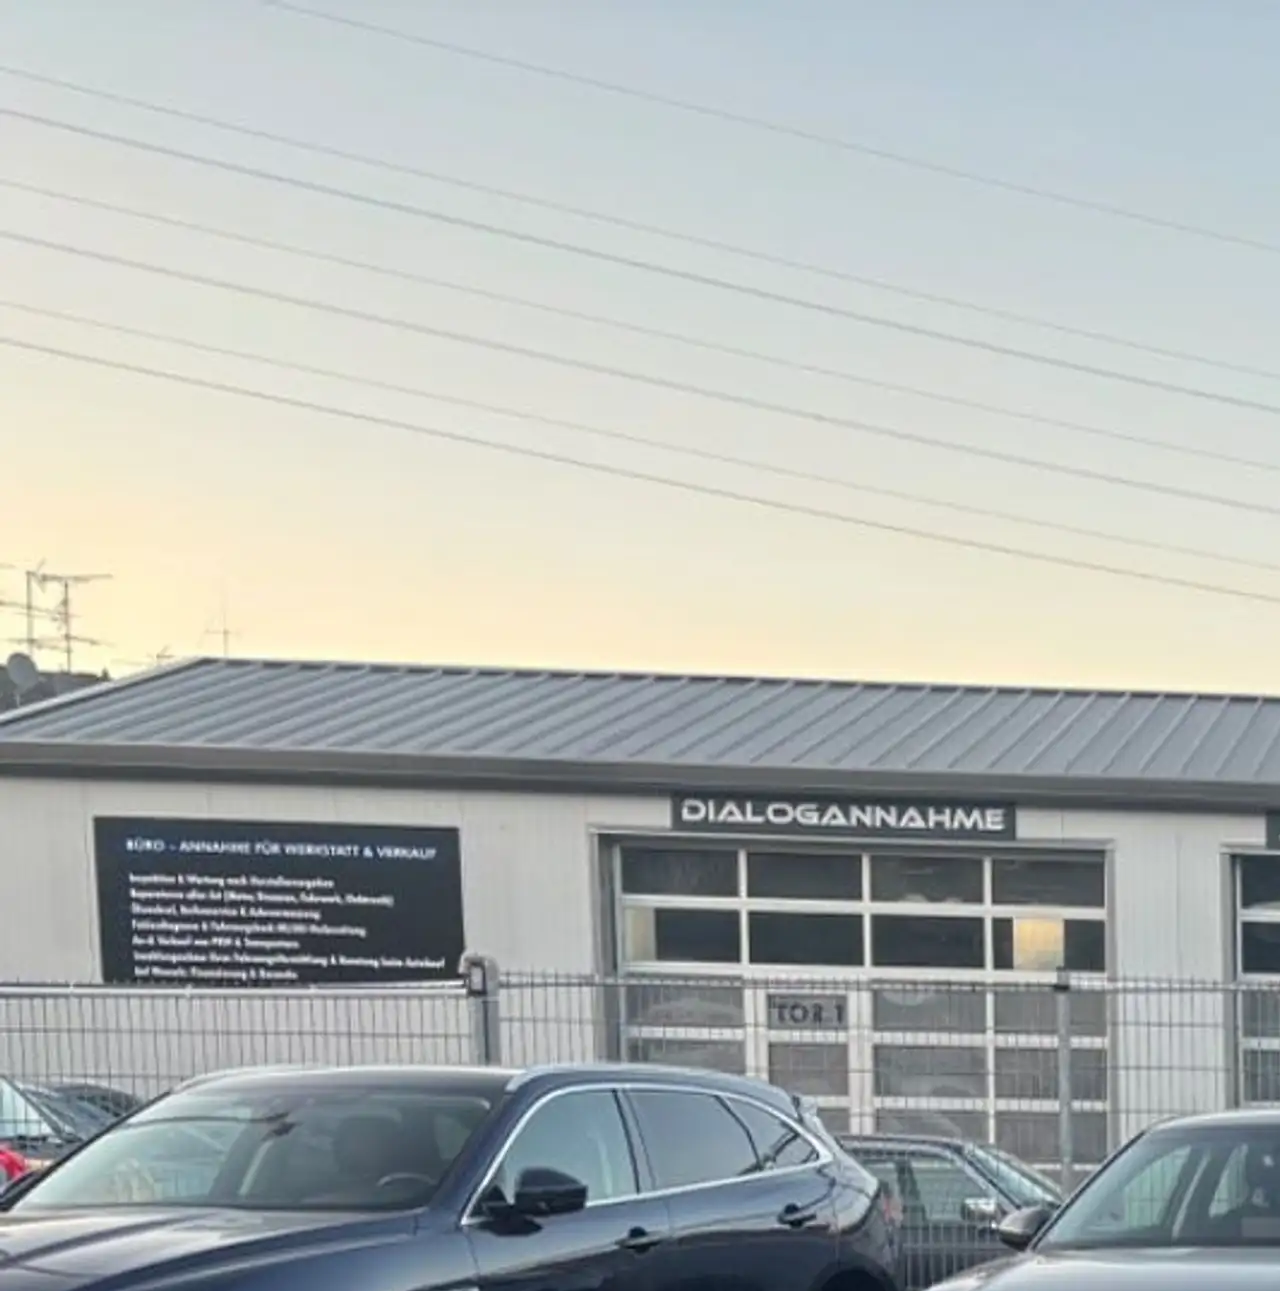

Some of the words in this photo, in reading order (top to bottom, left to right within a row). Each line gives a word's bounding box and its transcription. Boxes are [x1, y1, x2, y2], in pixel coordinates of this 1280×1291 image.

[681, 798, 1007, 832] DIALOGANNAHME
[126, 837, 165, 852] BÜRO
[179, 839, 251, 855] ANNAHME
[254, 838, 281, 856] FÜR
[285, 843, 359, 858] WERKSTATT
[363, 845, 374, 858] &
[376, 845, 437, 860] VERKAUF
[776, 1001, 823, 1024] TOR
[834, 1003, 845, 1024] 1
